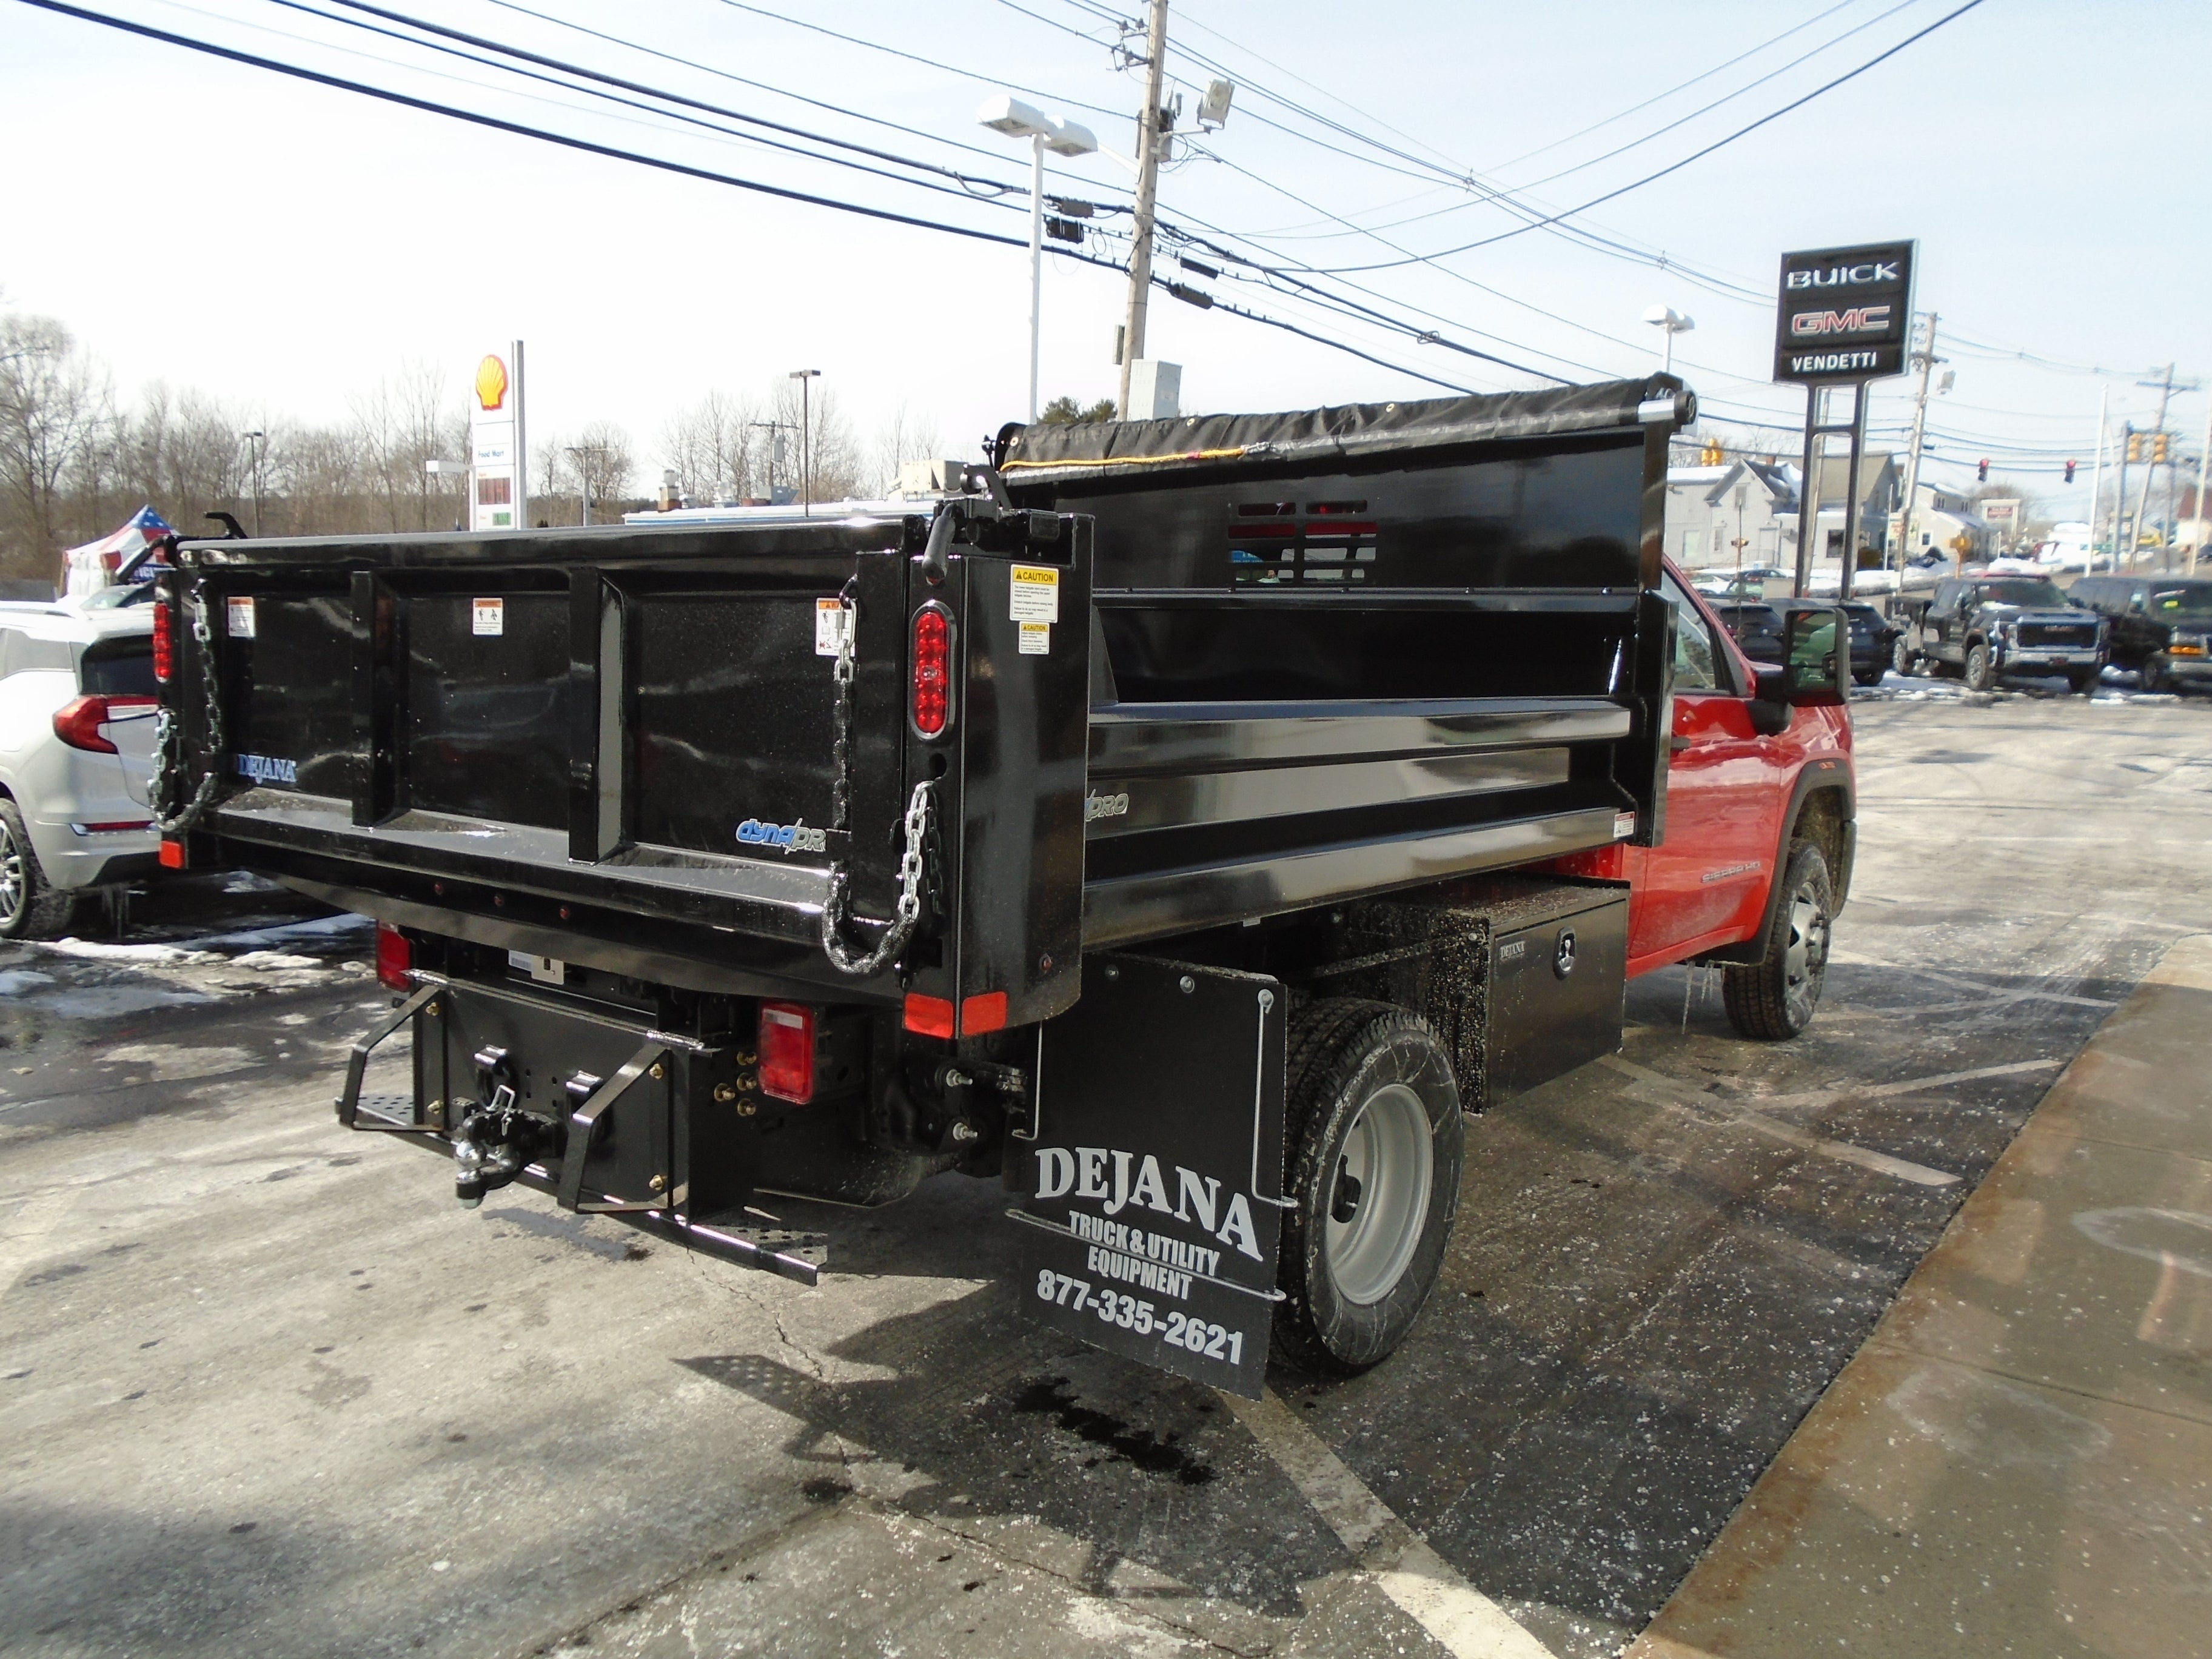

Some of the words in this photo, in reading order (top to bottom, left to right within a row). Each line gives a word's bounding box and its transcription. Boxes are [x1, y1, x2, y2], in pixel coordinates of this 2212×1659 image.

[1787, 261, 1900, 289] BUICK
[1792, 305, 1891, 337] GMC
[1792, 352, 1877, 373] VENDETTI
[1023, 572, 1054, 582] CAUTION
[237, 754, 298, 785] DEJANA
[1500, 940, 1526, 959] DEJANA
[1034, 1147, 1264, 1262] DEJANA
[1068, 1210, 1129, 1251] TRUCK
[1130, 1228, 1145, 1253] &
[1147, 1233, 1221, 1276] UTILITY
[1087, 1245, 1193, 1300] EQUIPMENT
[1036, 1268, 1244, 1366] 877-335-2621
